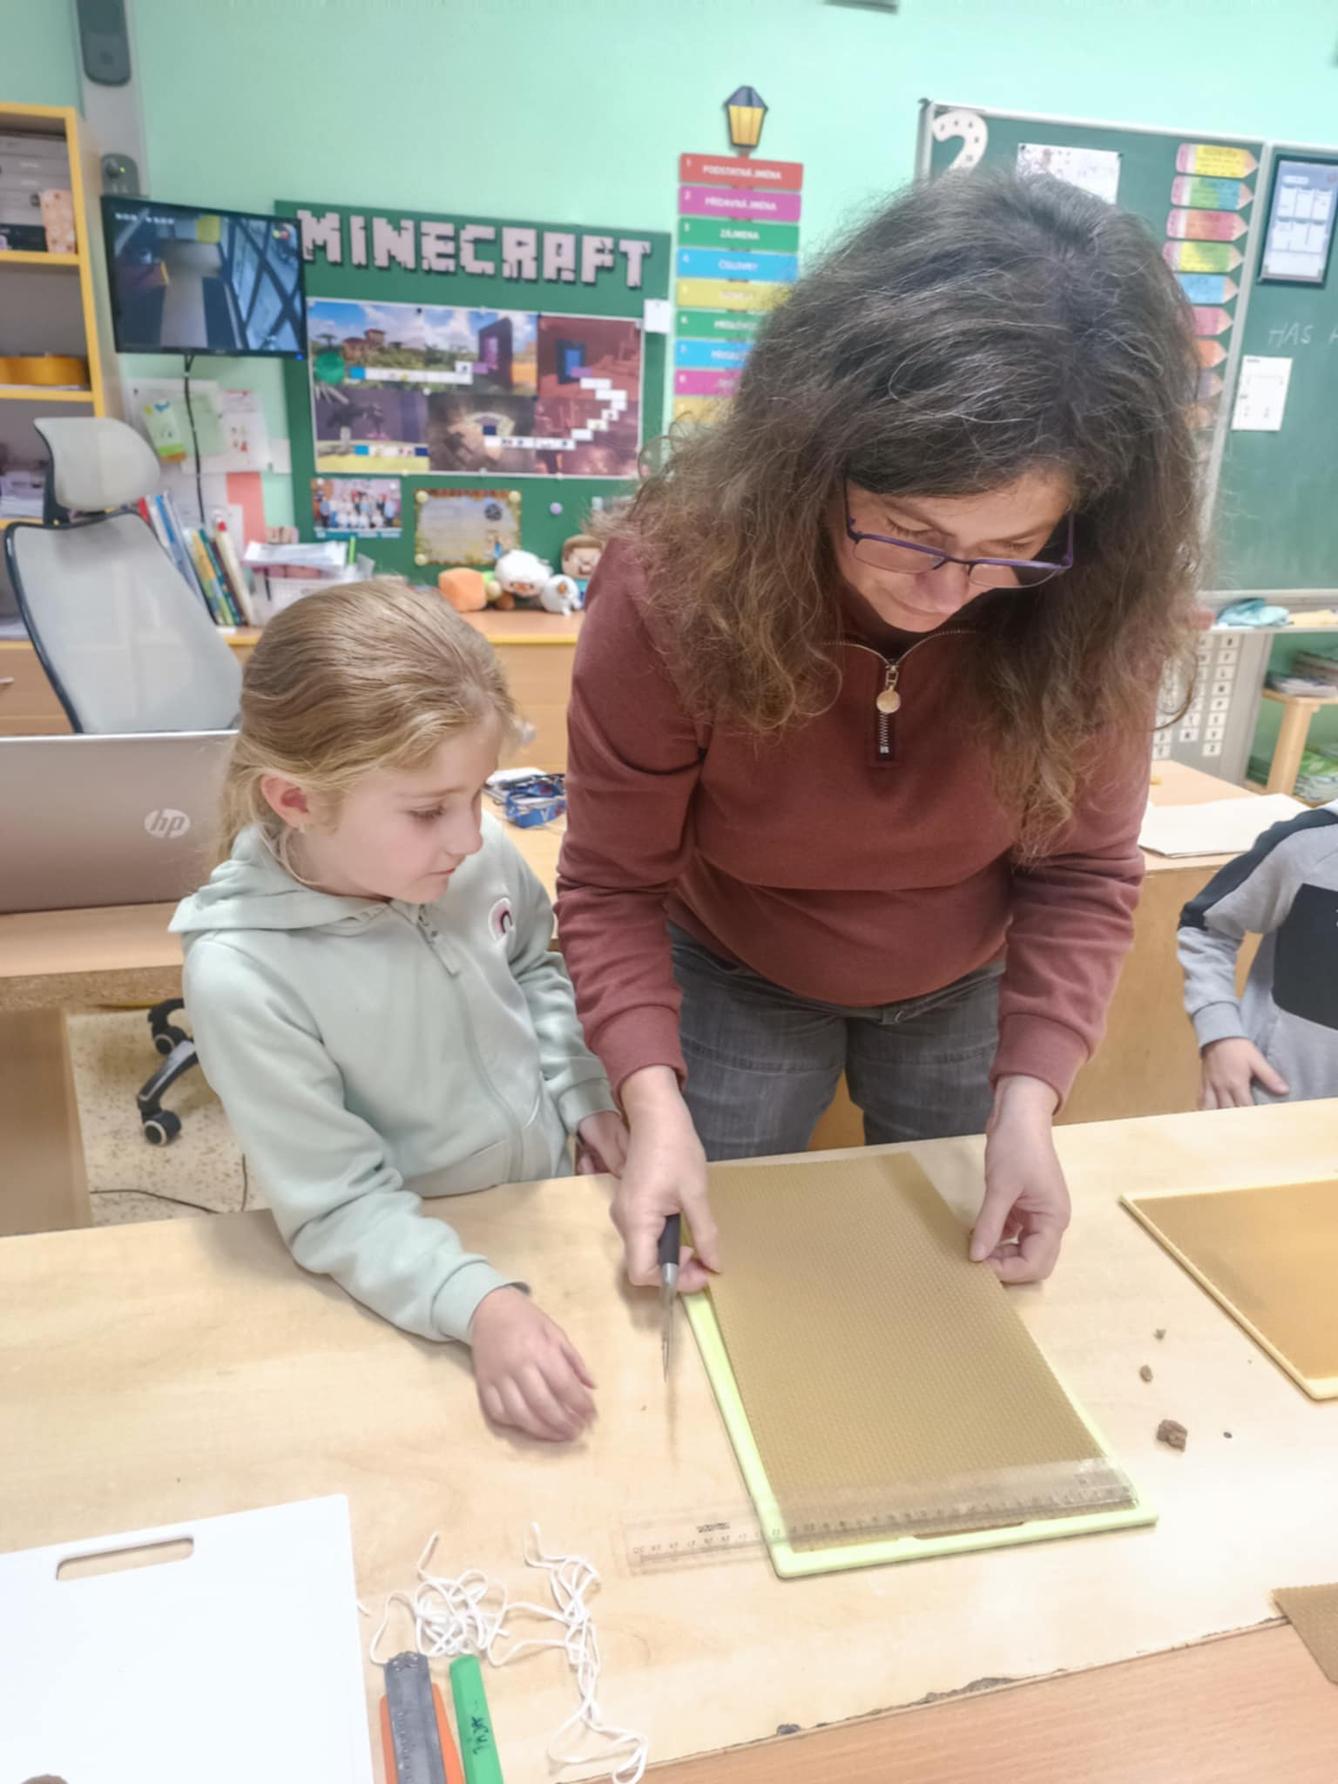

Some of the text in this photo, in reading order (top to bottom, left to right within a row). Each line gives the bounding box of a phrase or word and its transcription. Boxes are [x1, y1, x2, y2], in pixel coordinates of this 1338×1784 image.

[297, 209, 651, 288] MINECRAFT
[1268, 322, 1314, 348] HAS
[149, 809, 186, 839] hp
